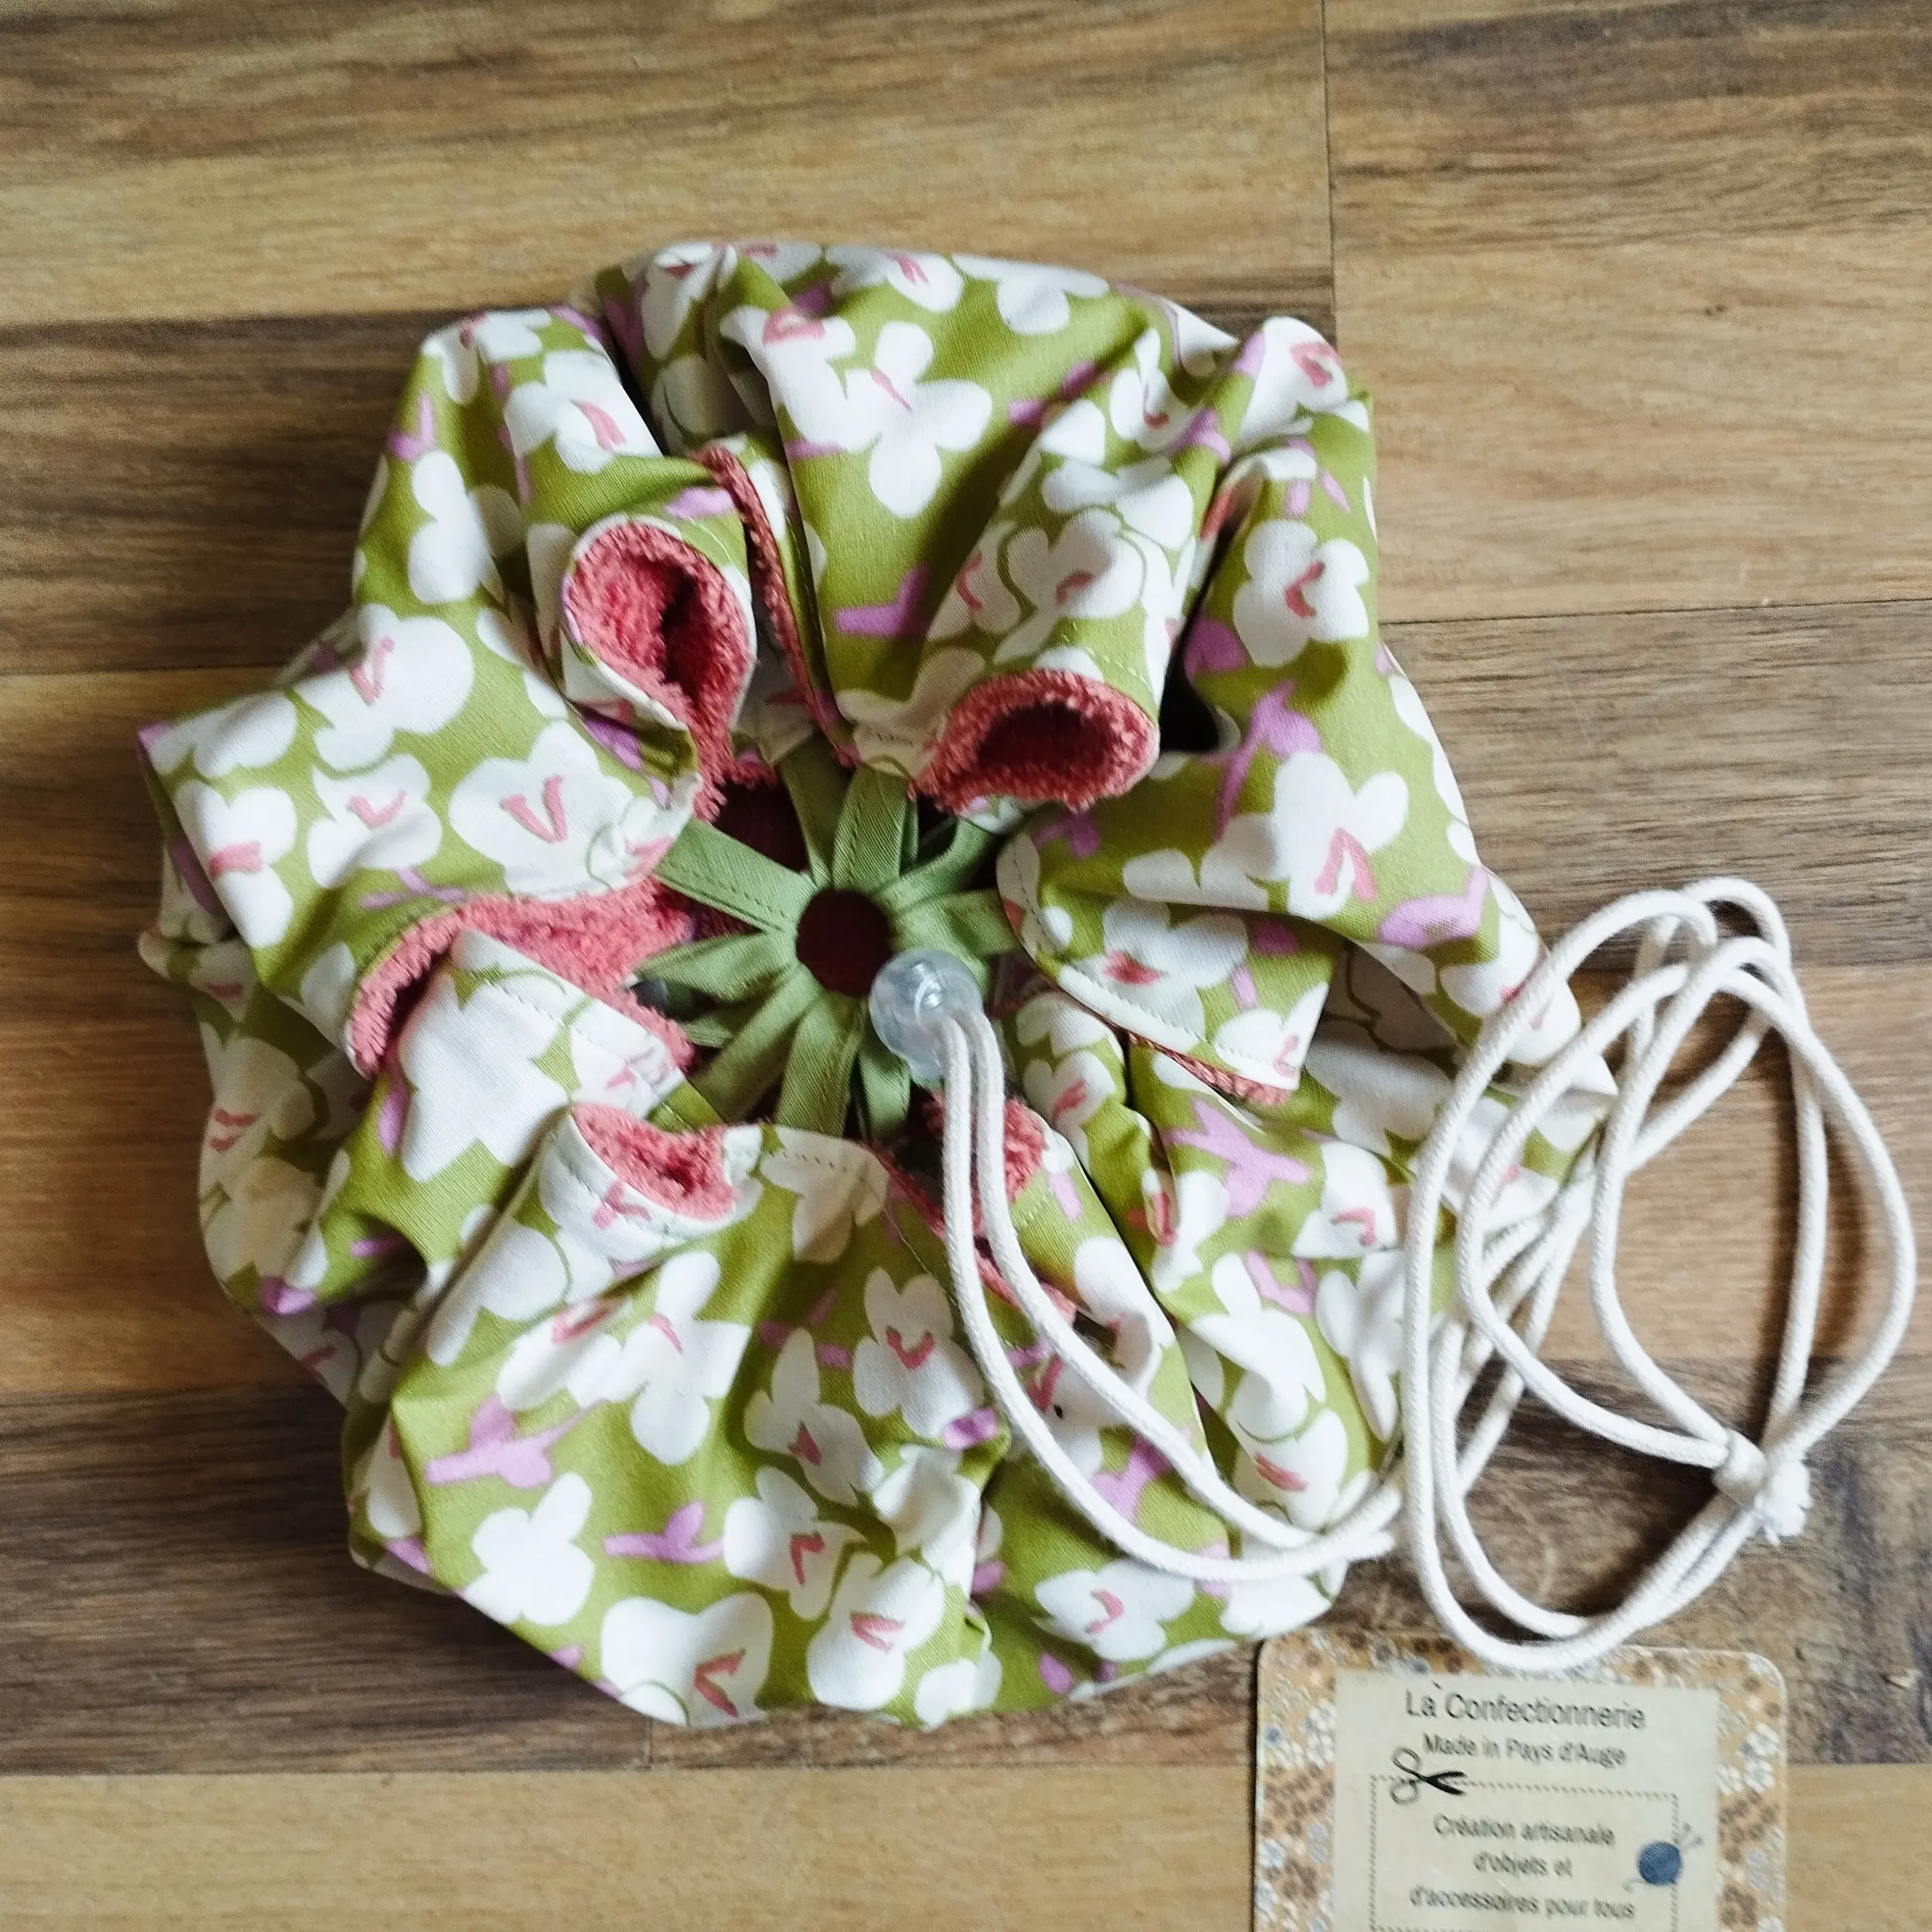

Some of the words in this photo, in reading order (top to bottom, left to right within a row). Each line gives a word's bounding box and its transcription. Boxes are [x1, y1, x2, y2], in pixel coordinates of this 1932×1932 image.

[1444, 1691, 1646, 1728] Confectionnerie
[1423, 1734, 1478, 1756] Made
[1481, 1735, 1500, 1759] in
[1506, 1737, 1554, 1764] Pays
[1558, 1740, 1627, 1768] d'Auge
[1433, 1813, 1516, 1840] Création
[1520, 1818, 1616, 1845] artisanale
[1473, 1850, 1549, 1880] d'objets
[1552, 1855, 1573, 1878] et
[1409, 1884, 1540, 1914] d'accessoires
[1545, 1897, 1588, 1919] pour
[1592, 1897, 1635, 1919] tous
